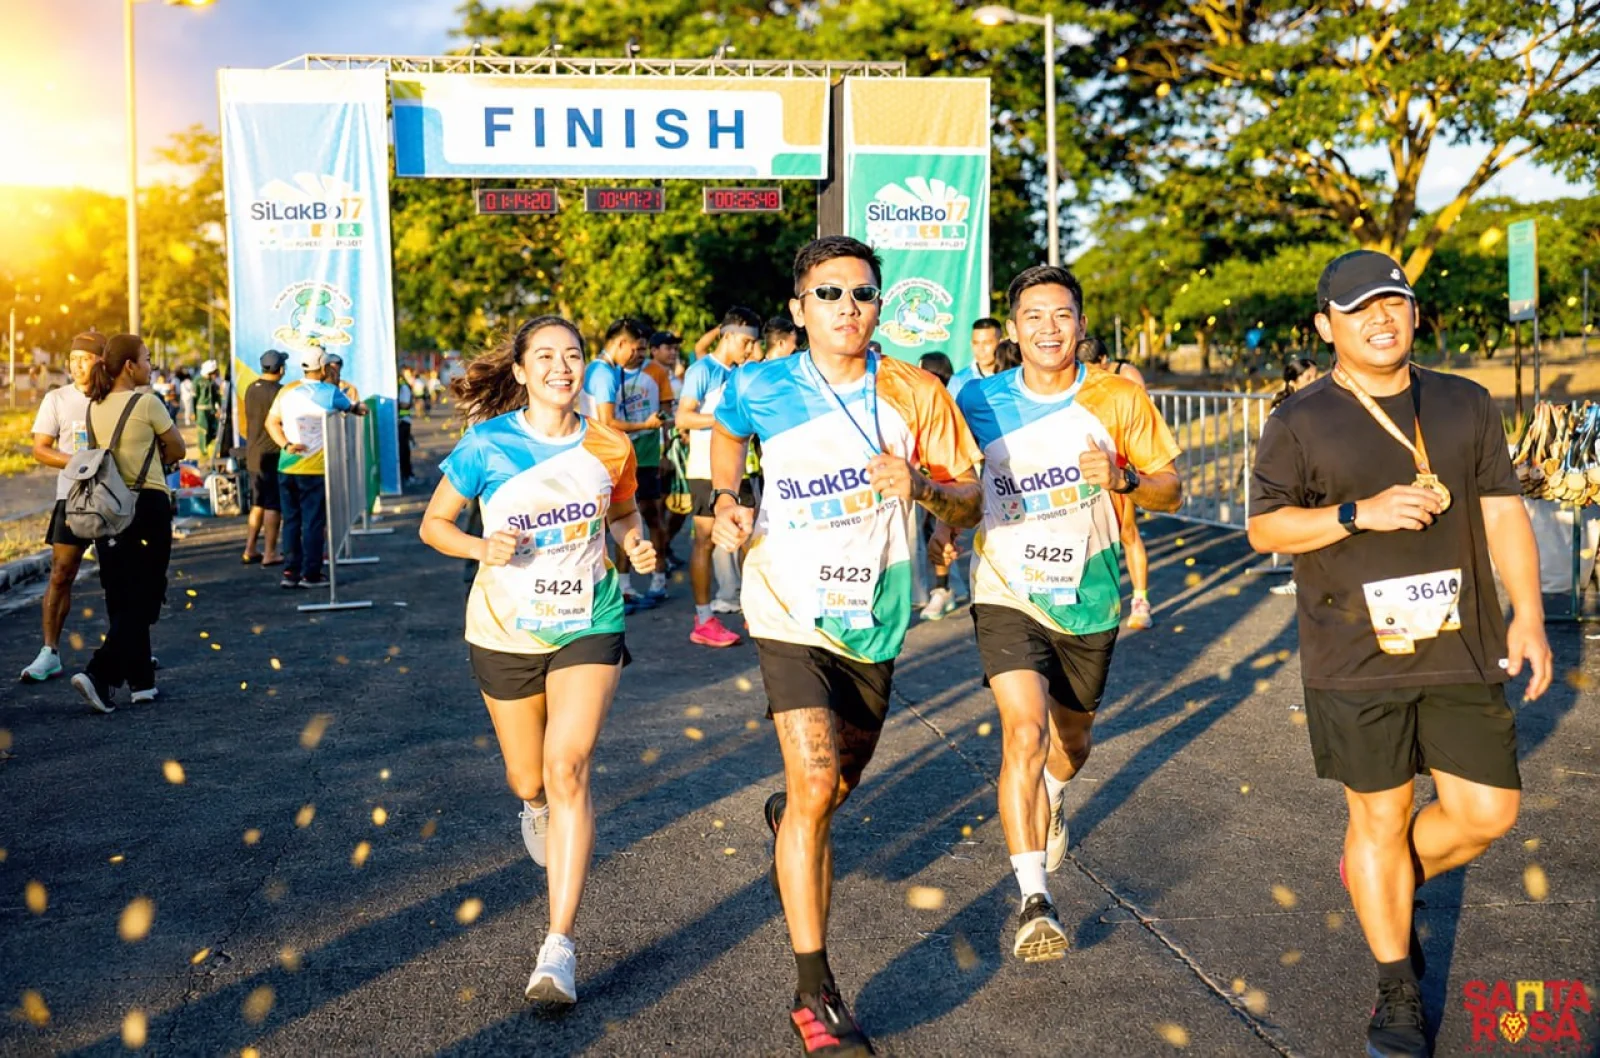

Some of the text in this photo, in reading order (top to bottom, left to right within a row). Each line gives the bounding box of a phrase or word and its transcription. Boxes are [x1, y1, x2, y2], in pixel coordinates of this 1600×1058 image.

[484, 106, 744, 149] FINISH
[598, 190, 661, 209] 00:47:21
[714, 190, 779, 209] 00:25:48
[994, 465, 1081, 496] SiLakBo
[1024, 544, 1074, 563] 5425
[819, 565, 872, 583] 5423
[1024, 567, 1046, 583] 5K
[534, 579, 583, 595] 5424
[534, 602, 557, 617] 5K
